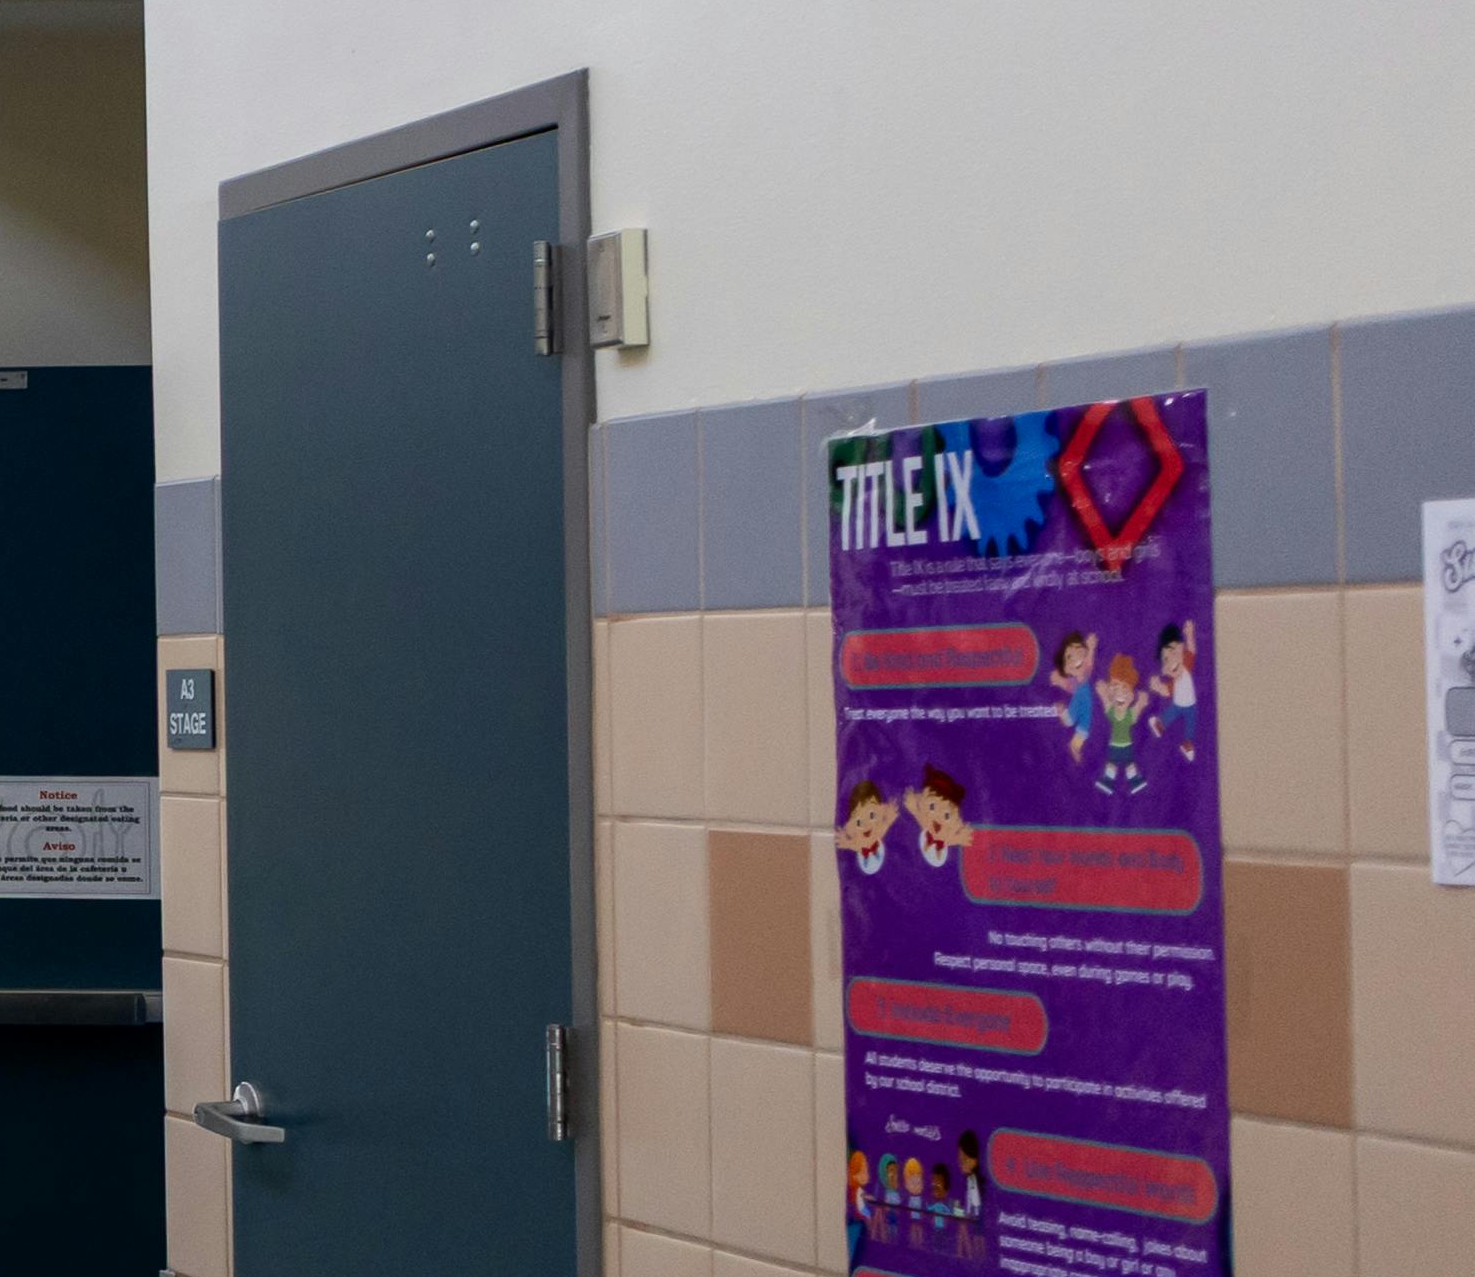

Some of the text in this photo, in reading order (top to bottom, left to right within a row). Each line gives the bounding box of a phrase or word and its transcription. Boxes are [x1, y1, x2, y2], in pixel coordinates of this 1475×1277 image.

[836, 450, 981, 551] TITLE IX
[180, 678, 195, 700] A3
[170, 712, 207, 735] STAGE
[866, 708, 909, 722] everyone
[947, 708, 964, 722] you
[991, 706, 1003, 719] to
[1004, 704, 1016, 719] be
[40, 790, 78, 800] Notice
[21, 804, 51, 813] should
[53, 804, 64, 813] be
[67, 805, 93, 813] taken
[95, 805, 117, 813] from
[120, 805, 135, 813] the
[32, 814, 57, 822] other
[60, 814, 110, 824] designated
[42, 842, 76, 851] Aviso
[20, 864, 34, 872] del
[41, 856, 56, 865] que
[988, 930, 1003, 945] No
[1004, 933, 1047, 952] touching
[1084, 937, 1123, 954] without
[934, 951, 971, 969] Respect
[972, 957, 1015, 972] personal
[1051, 965, 1076, 977] even
[1078, 963, 1112, 984] during
[1114, 969, 1150, 985] games
[1152, 972, 1164, 984] or
[865, 1051, 877, 1065] All
[878, 1054, 917, 1071] students
[918, 1058, 956, 1075] deserve
[956, 1062, 973, 1078] the
[974, 1068, 1031, 1089] opportunity
[1031, 1074, 1043, 1088] to
[1045, 1076, 1101, 1096] participate
[865, 1071, 877, 1089] by
[895, 1076, 925, 1092] school
[998, 1212, 1026, 1229] Avoid
[1174, 1243, 1207, 1263] about
[999, 1235, 1045, 1253] someone
[1046, 1241, 1074, 1264] being
[1085, 1249, 1105, 1270] boy
